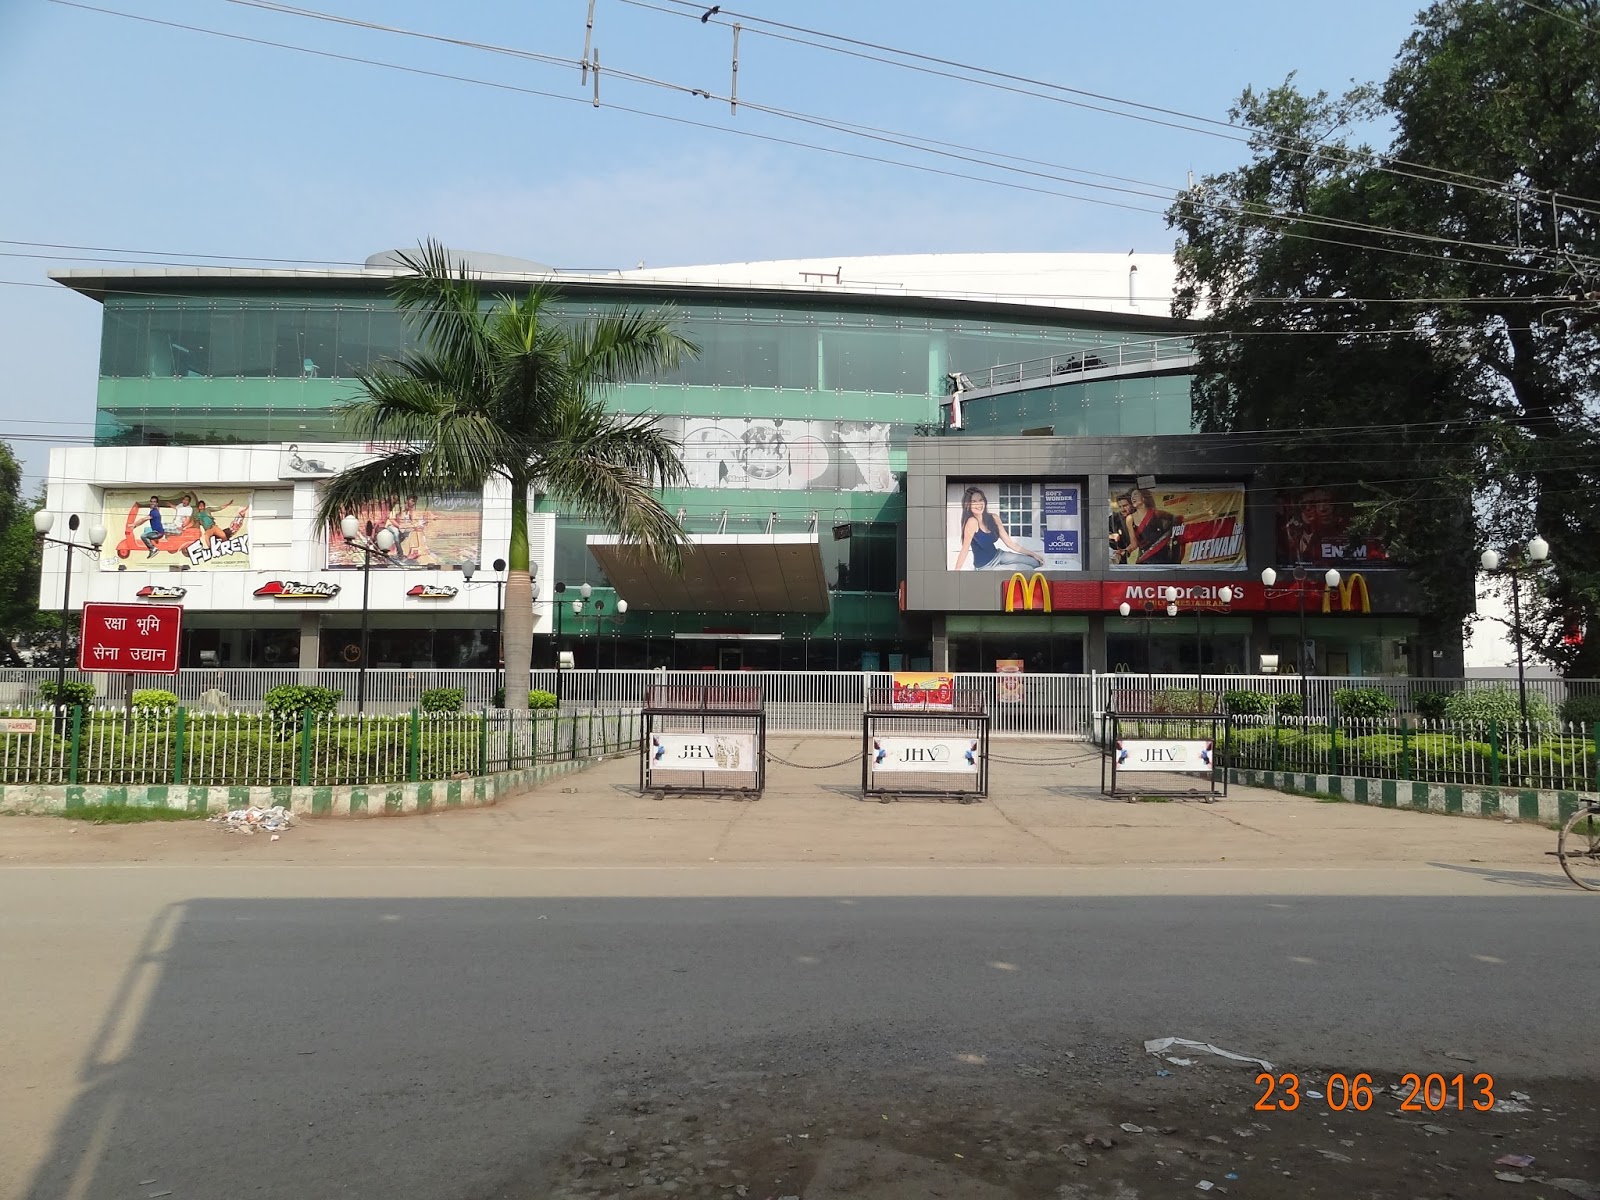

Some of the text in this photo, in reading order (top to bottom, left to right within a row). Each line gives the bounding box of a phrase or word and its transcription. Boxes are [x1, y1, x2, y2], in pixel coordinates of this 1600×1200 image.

[1189, 534, 1243, 562] DEEWANI
[282, 582, 312, 595] Pizza
[1125, 584, 1244, 599] McDonal's
[104, 614, 161, 635] रक्षा भूमि
[93, 643, 167, 661] सेना उद्यान
[677, 745, 714, 759] JHV
[899, 748, 936, 762] JHV
[1140, 748, 1177, 762] JHV
